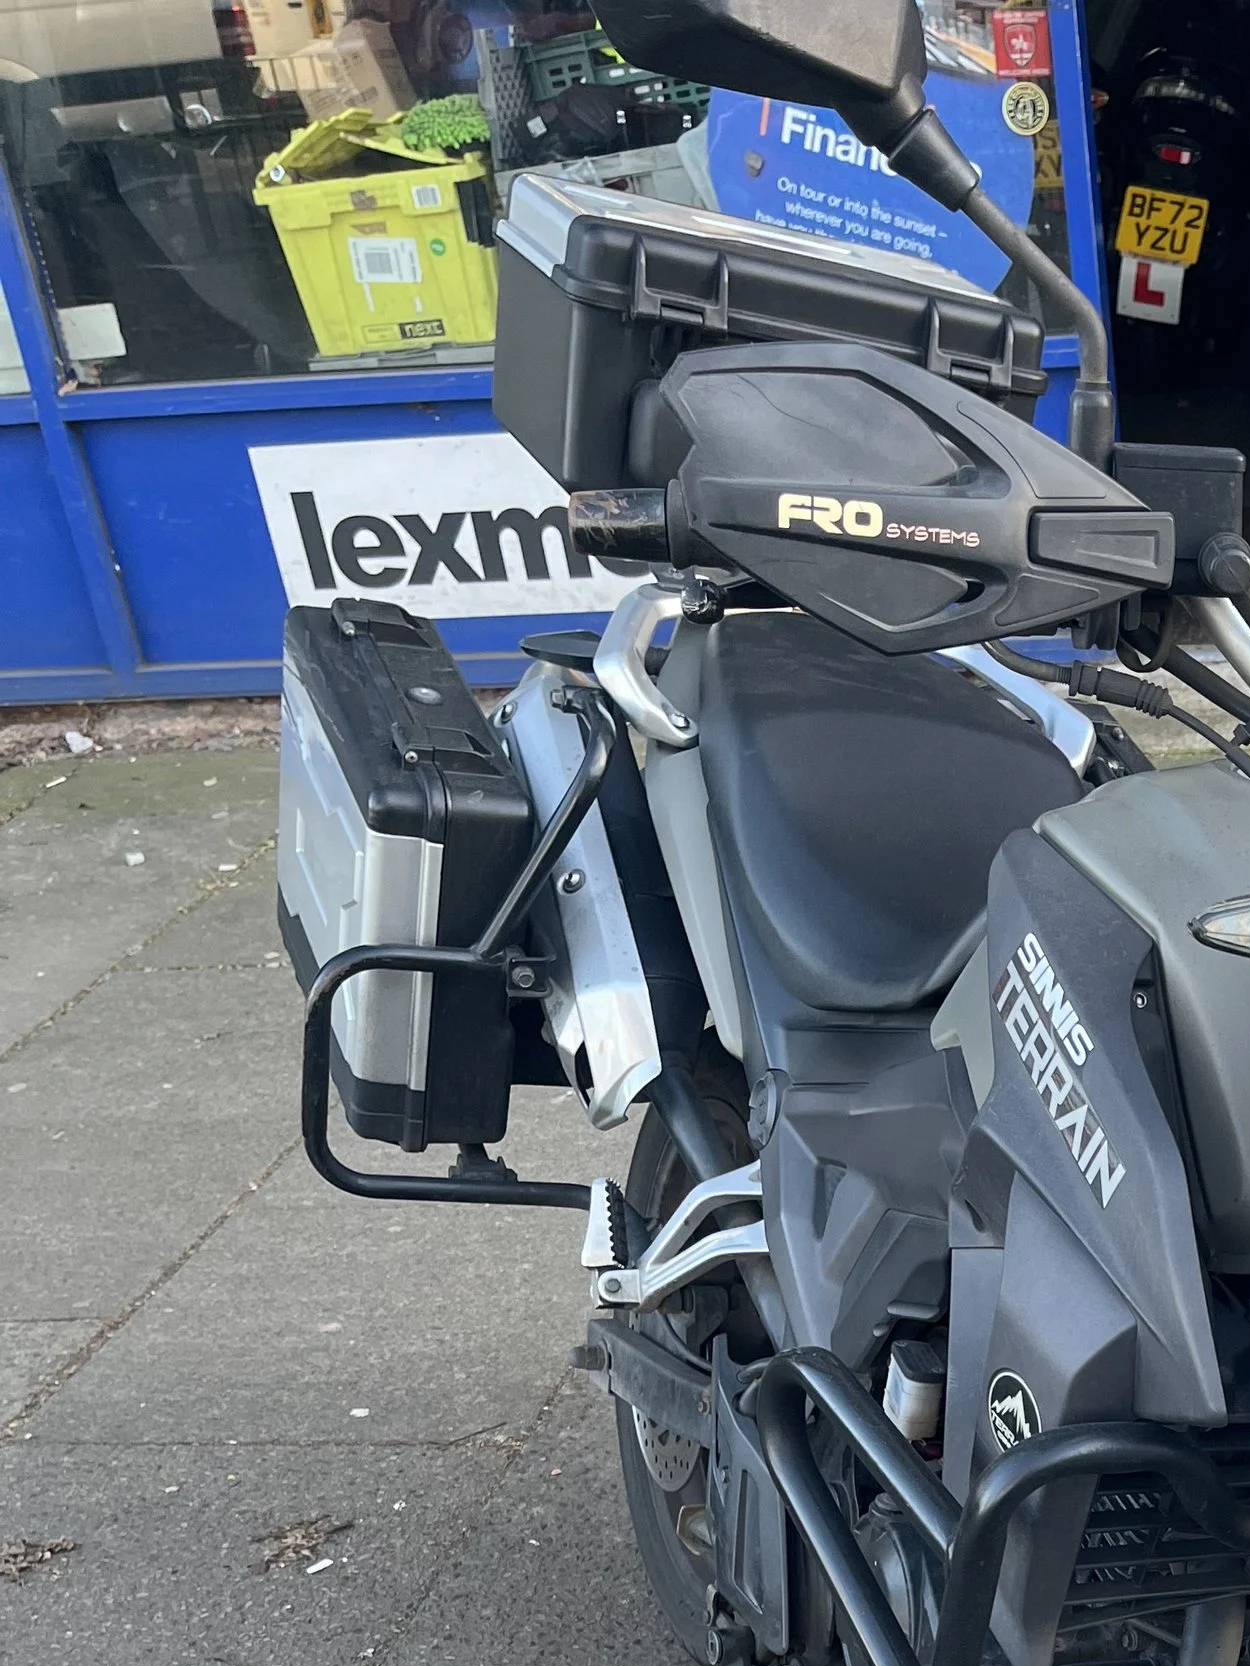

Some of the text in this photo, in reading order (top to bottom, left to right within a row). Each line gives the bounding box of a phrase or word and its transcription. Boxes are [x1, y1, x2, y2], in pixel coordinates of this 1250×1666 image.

[777, 177, 797, 194] On
[800, 183, 826, 203] tour
[827, 194, 843, 208] or
[844, 197, 869, 217] into
[871, 206, 892, 225] the
[1127, 193, 1204, 230] BF72
[785, 200, 843, 229] wherever
[844, 218, 869, 237] you
[871, 228, 892, 244] are
[893, 236, 933, 259] going,
[1135, 221, 1189, 255] YZU
[1133, 261, 1165, 308] L
[290, 490, 654, 590] lexm
[778, 493, 981, 548] FRO SYSTEMS
[1017, 932, 1095, 1067] SINNIS
[996, 959, 1127, 1210] TERRAIN
